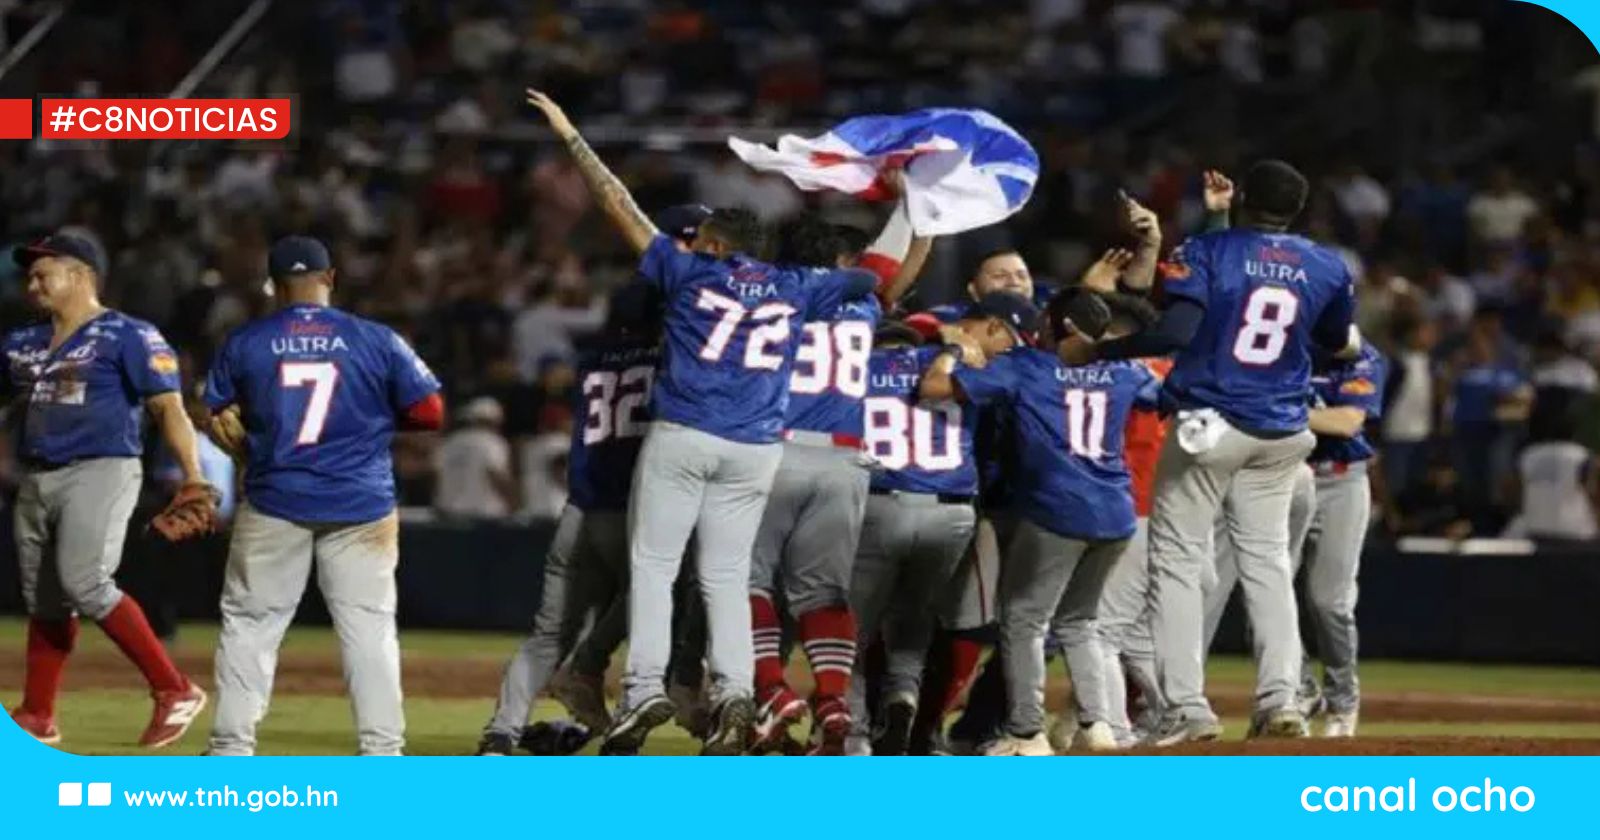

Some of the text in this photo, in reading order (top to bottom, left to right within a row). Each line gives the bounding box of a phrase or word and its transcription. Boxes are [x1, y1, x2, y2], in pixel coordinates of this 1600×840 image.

[1244, 259, 1308, 284] ULTRA
[271, 335, 350, 355] ULTRA
[697, 287, 799, 372] 72
[1232, 285, 1299, 365] 8
[280, 360, 341, 447] 7
[583, 366, 655, 446] 32
[1055, 366, 1115, 386] ULTRA
[863, 396, 963, 470] 80
[1064, 388, 1107, 460] 11
